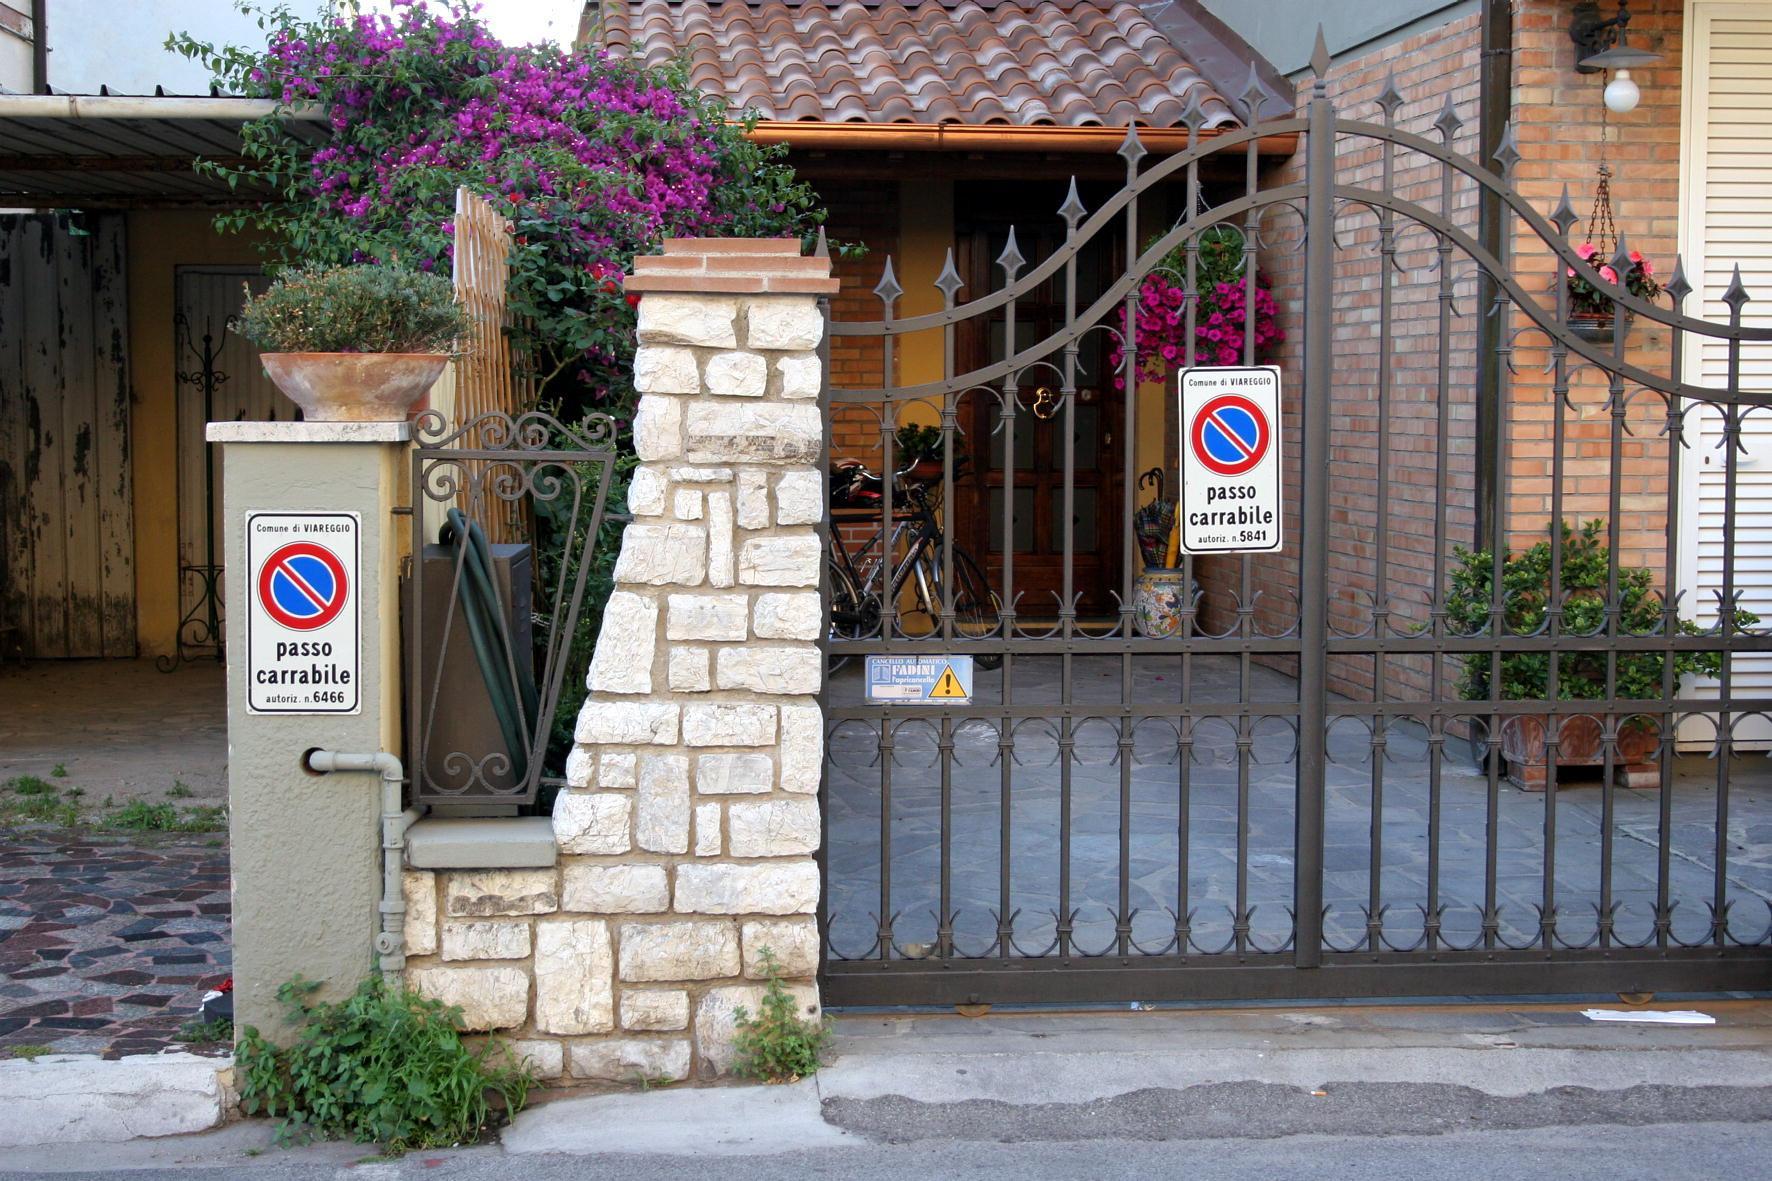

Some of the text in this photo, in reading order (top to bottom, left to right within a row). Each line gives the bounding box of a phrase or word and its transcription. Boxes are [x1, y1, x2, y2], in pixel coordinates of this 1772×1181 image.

[1188, 377, 1271, 387] Comune di VIAREGGIO
[1207, 485, 1256, 505] passo
[1189, 505, 1273, 526] carrabile
[256, 523, 350, 533] Comune di VIAREGGIO
[1198, 534, 1229, 543] autoriz.
[276, 642, 332, 661] passo
[256, 664, 350, 684] carrabile
[892, 665, 935, 675] FADINI
[266, 694, 301, 703] autoriz.
